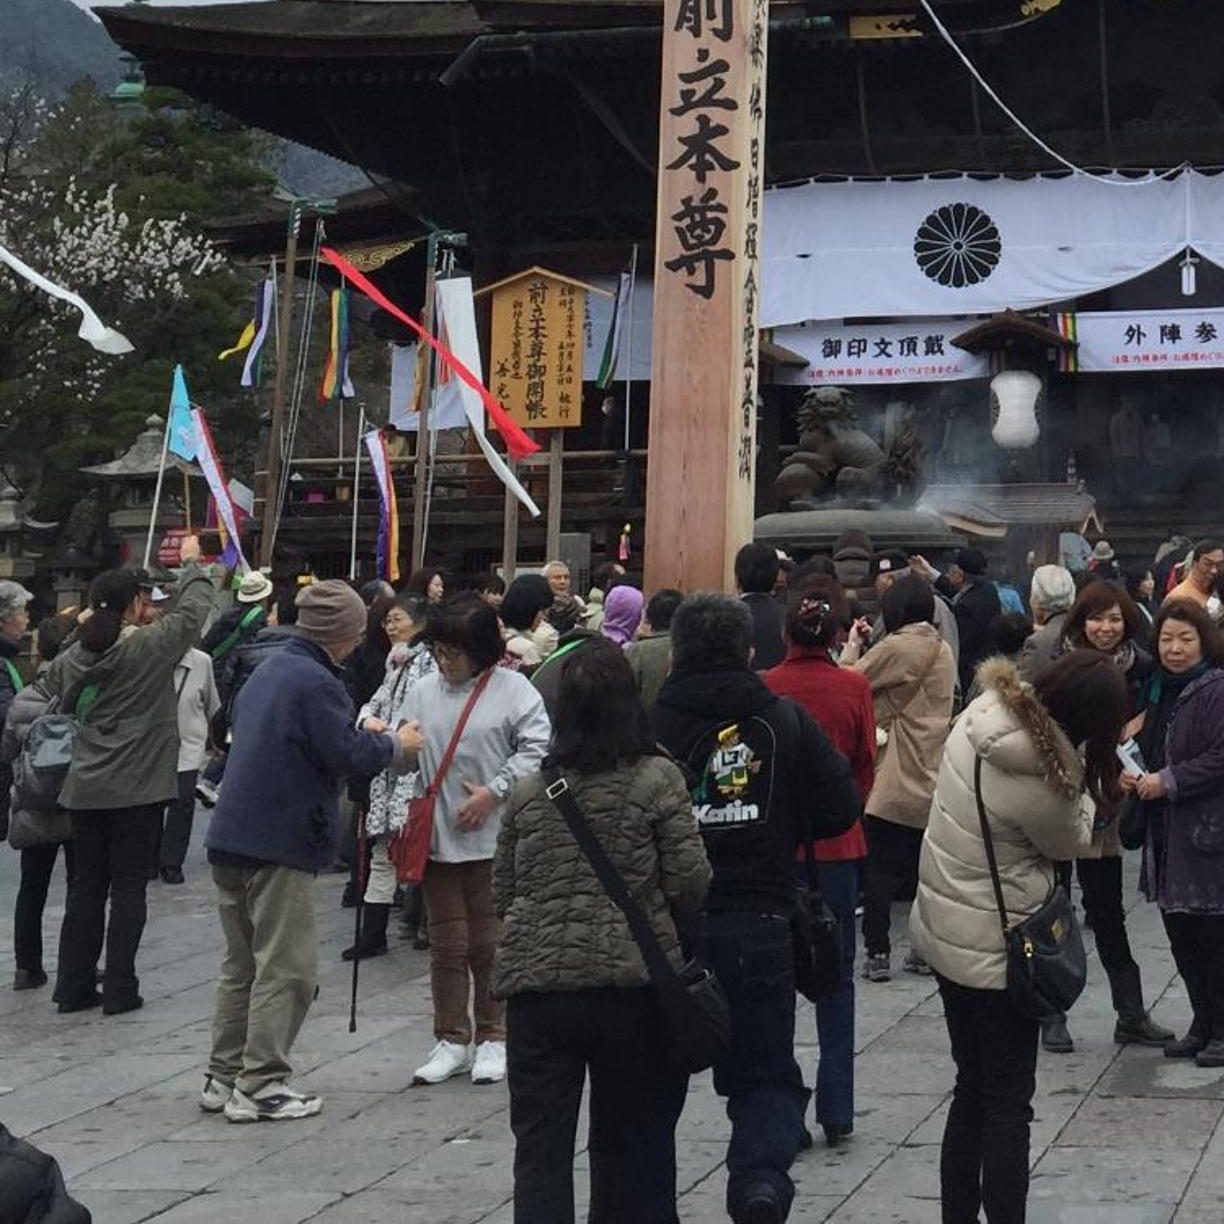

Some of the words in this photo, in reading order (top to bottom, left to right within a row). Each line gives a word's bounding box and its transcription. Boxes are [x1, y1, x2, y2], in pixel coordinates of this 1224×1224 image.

[527, 281, 548, 420] 前立本尊御開帳
[821, 334, 946, 359] 御印文頂戴
